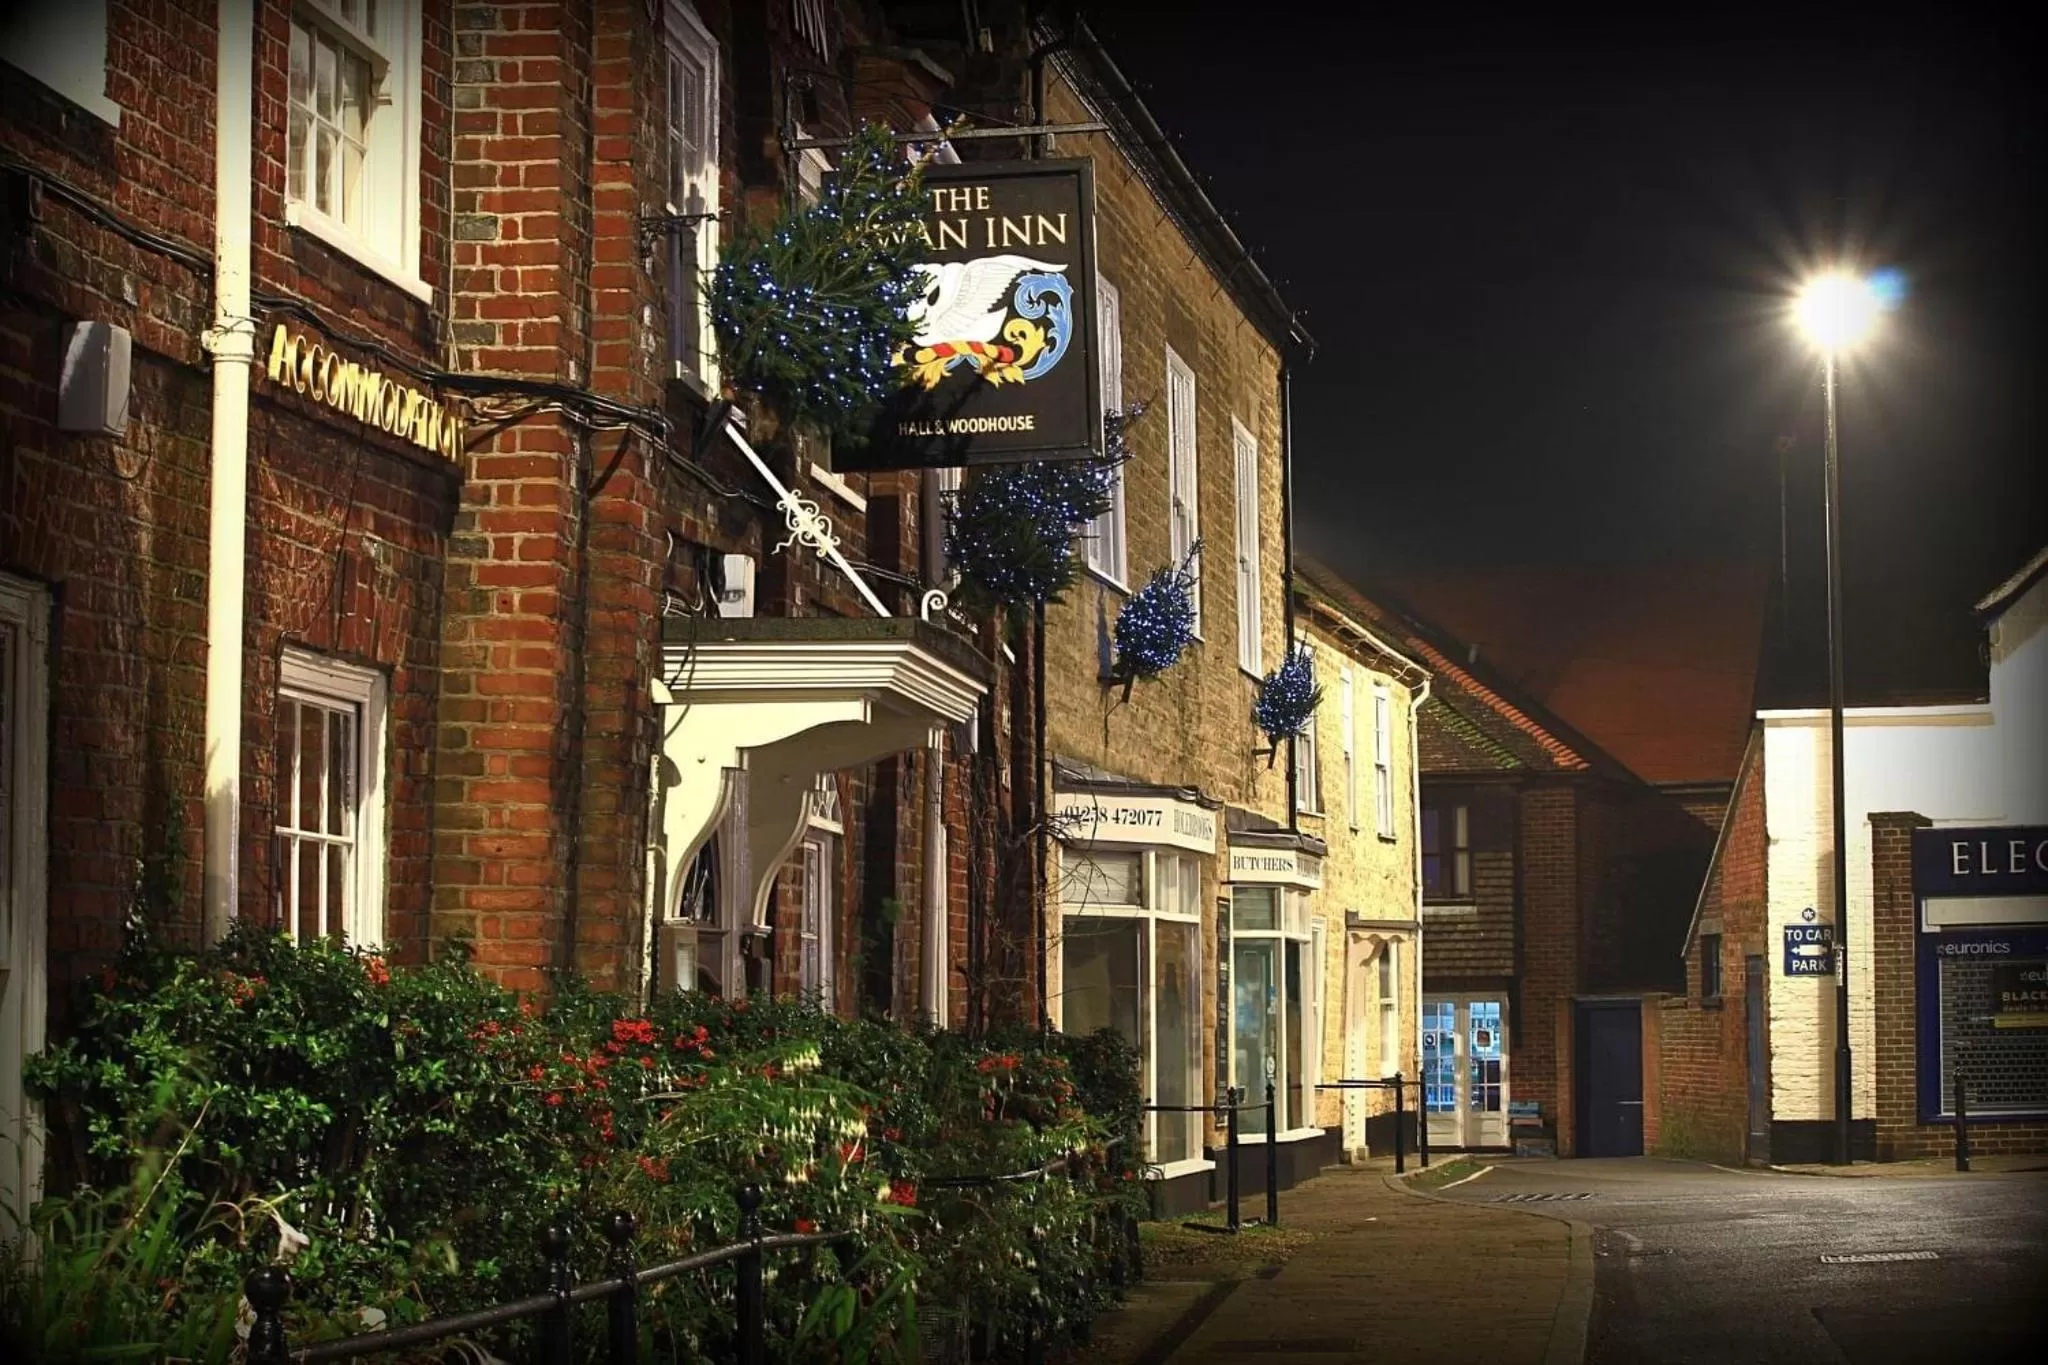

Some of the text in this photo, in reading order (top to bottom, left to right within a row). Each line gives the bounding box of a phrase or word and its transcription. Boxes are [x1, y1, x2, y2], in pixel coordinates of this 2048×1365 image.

[932, 186, 990, 213] THE
[986, 213, 1067, 248] INN
[899, 415, 1036, 436] HALL & WOODHOUSE
[1112, 807, 1164, 827] 472077
[1233, 855, 1294, 872] BUTCHERS
[1785, 929, 1832, 941] TO CAR
[1945, 940, 2011, 955] euronics
[1791, 959, 1828, 972] PARK
